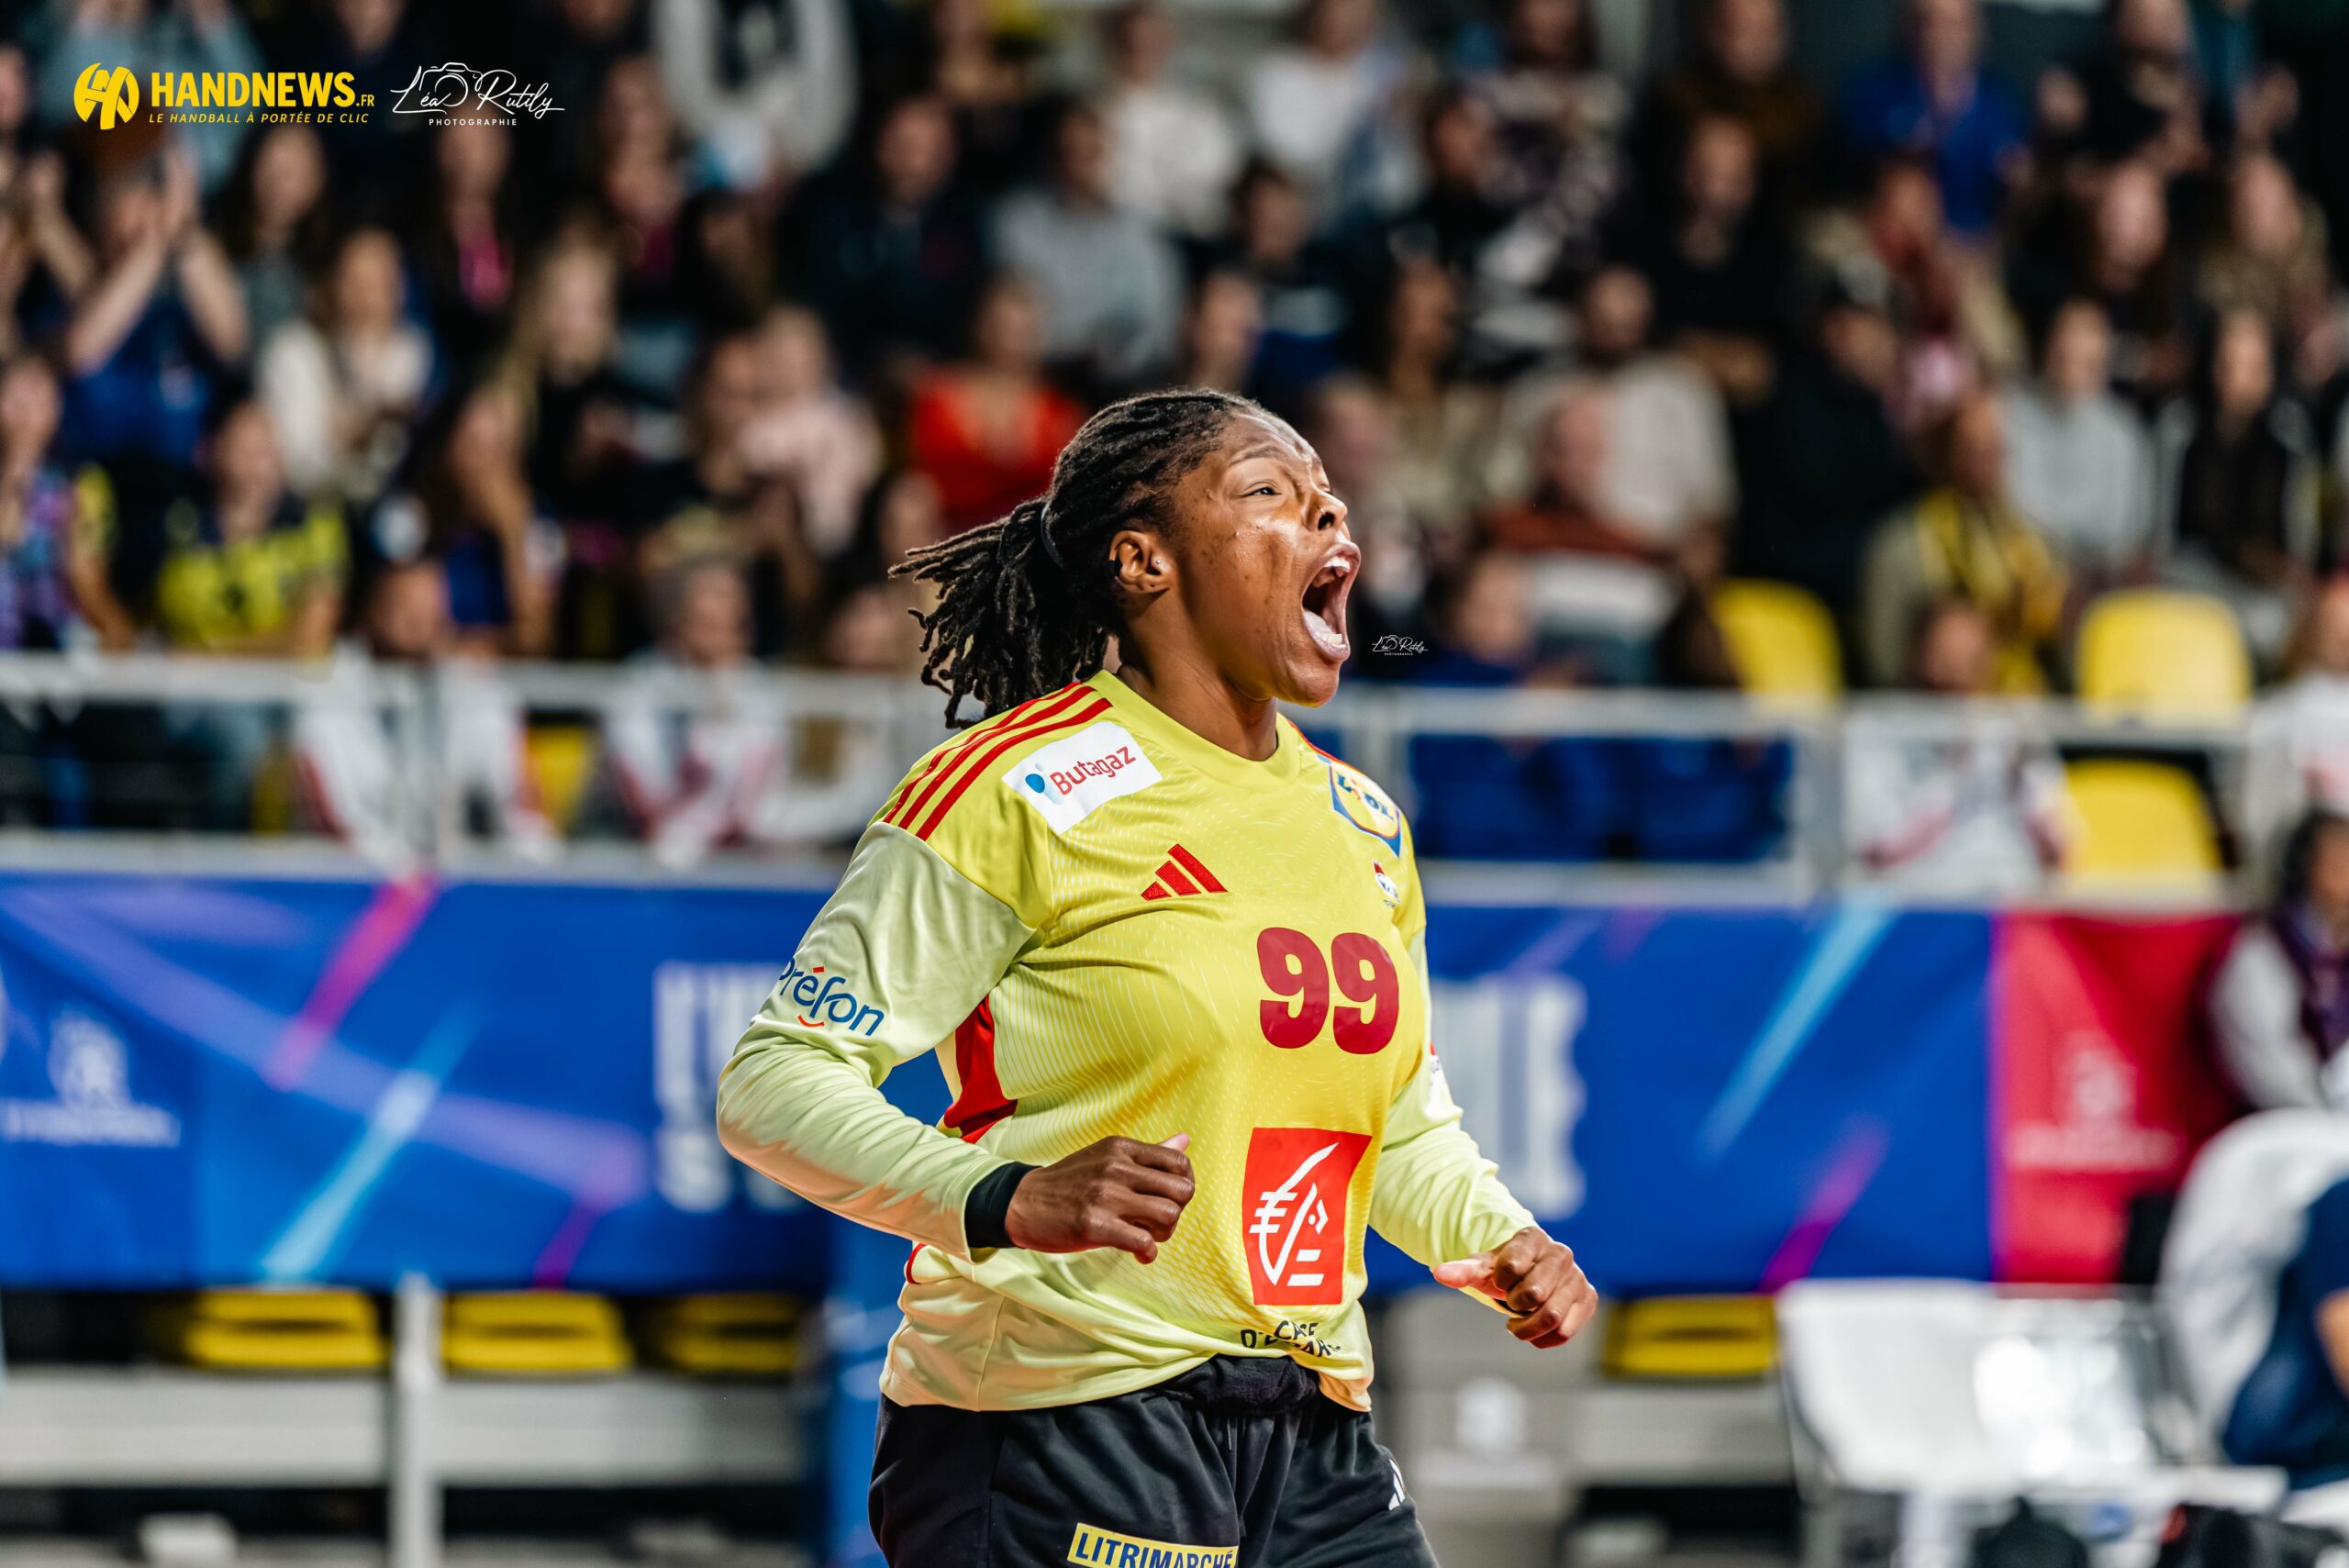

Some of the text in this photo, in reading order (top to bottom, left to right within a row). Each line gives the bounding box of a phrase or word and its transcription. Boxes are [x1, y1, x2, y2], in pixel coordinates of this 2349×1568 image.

[1049, 746, 1137, 796] Butagaz
[1256, 927, 1400, 1055] 99
[1074, 1532, 1234, 1568] LITRIMARCHÉ
